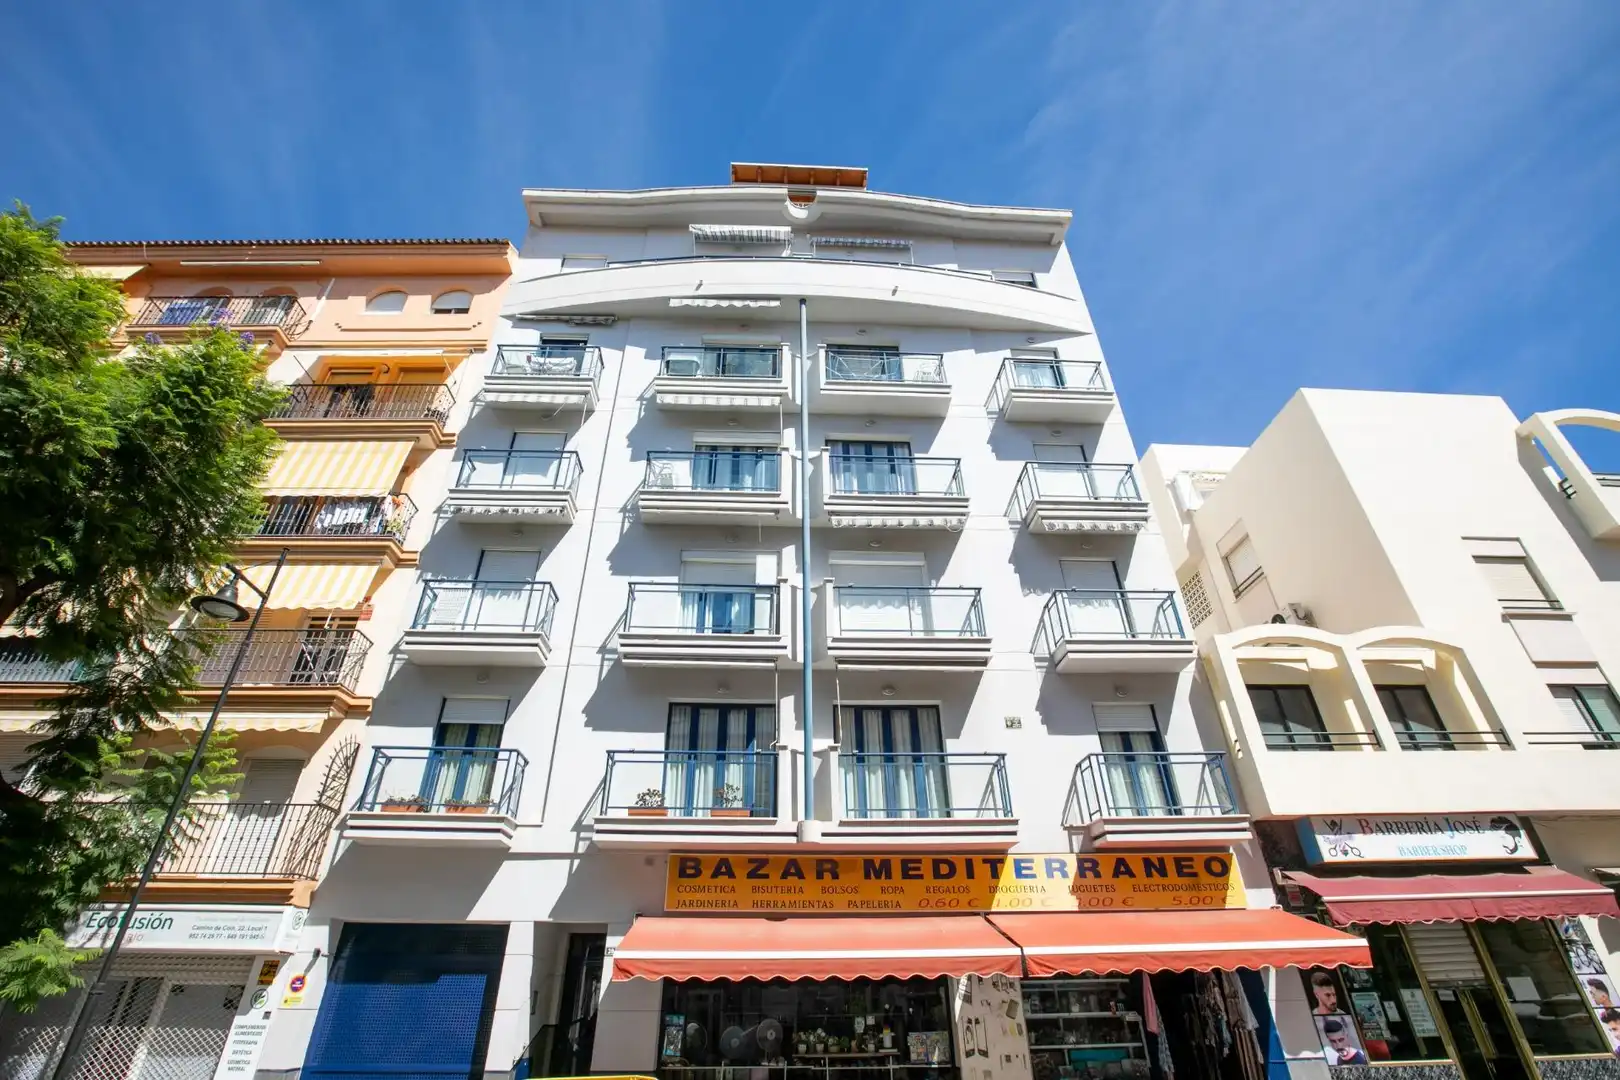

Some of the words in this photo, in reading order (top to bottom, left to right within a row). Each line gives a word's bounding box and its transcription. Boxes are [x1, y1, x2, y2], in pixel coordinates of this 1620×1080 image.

[1356, 815, 1443, 835] BARBERÍA
[1443, 815, 1484, 838] JOSÉ
[1398, 844, 1440, 857] BARBER
[1440, 844, 1468, 857] SHOP
[677, 857, 840, 880] BAZAR
[862, 856, 1230, 880] MEDITERRANEO
[677, 884, 736, 894] COSMETICA
[751, 885, 805, 895] BISUTERIA
[820, 885, 859, 895] BOLSOS
[880, 885, 905, 895] ROPA
[925, 885, 971, 895] REGALOS
[988, 885, 1047, 895] DROGUERIA
[1067, 884, 1117, 895] JUGUETES
[1132, 882, 1236, 893] ELECTRODOMESTICOS
[676, 898, 739, 909] JARDINERIA
[752, 899, 835, 909] HERRAMIENTAS
[847, 899, 902, 909] PAPELERIA
[1171, 896, 1214, 906] 5.00
